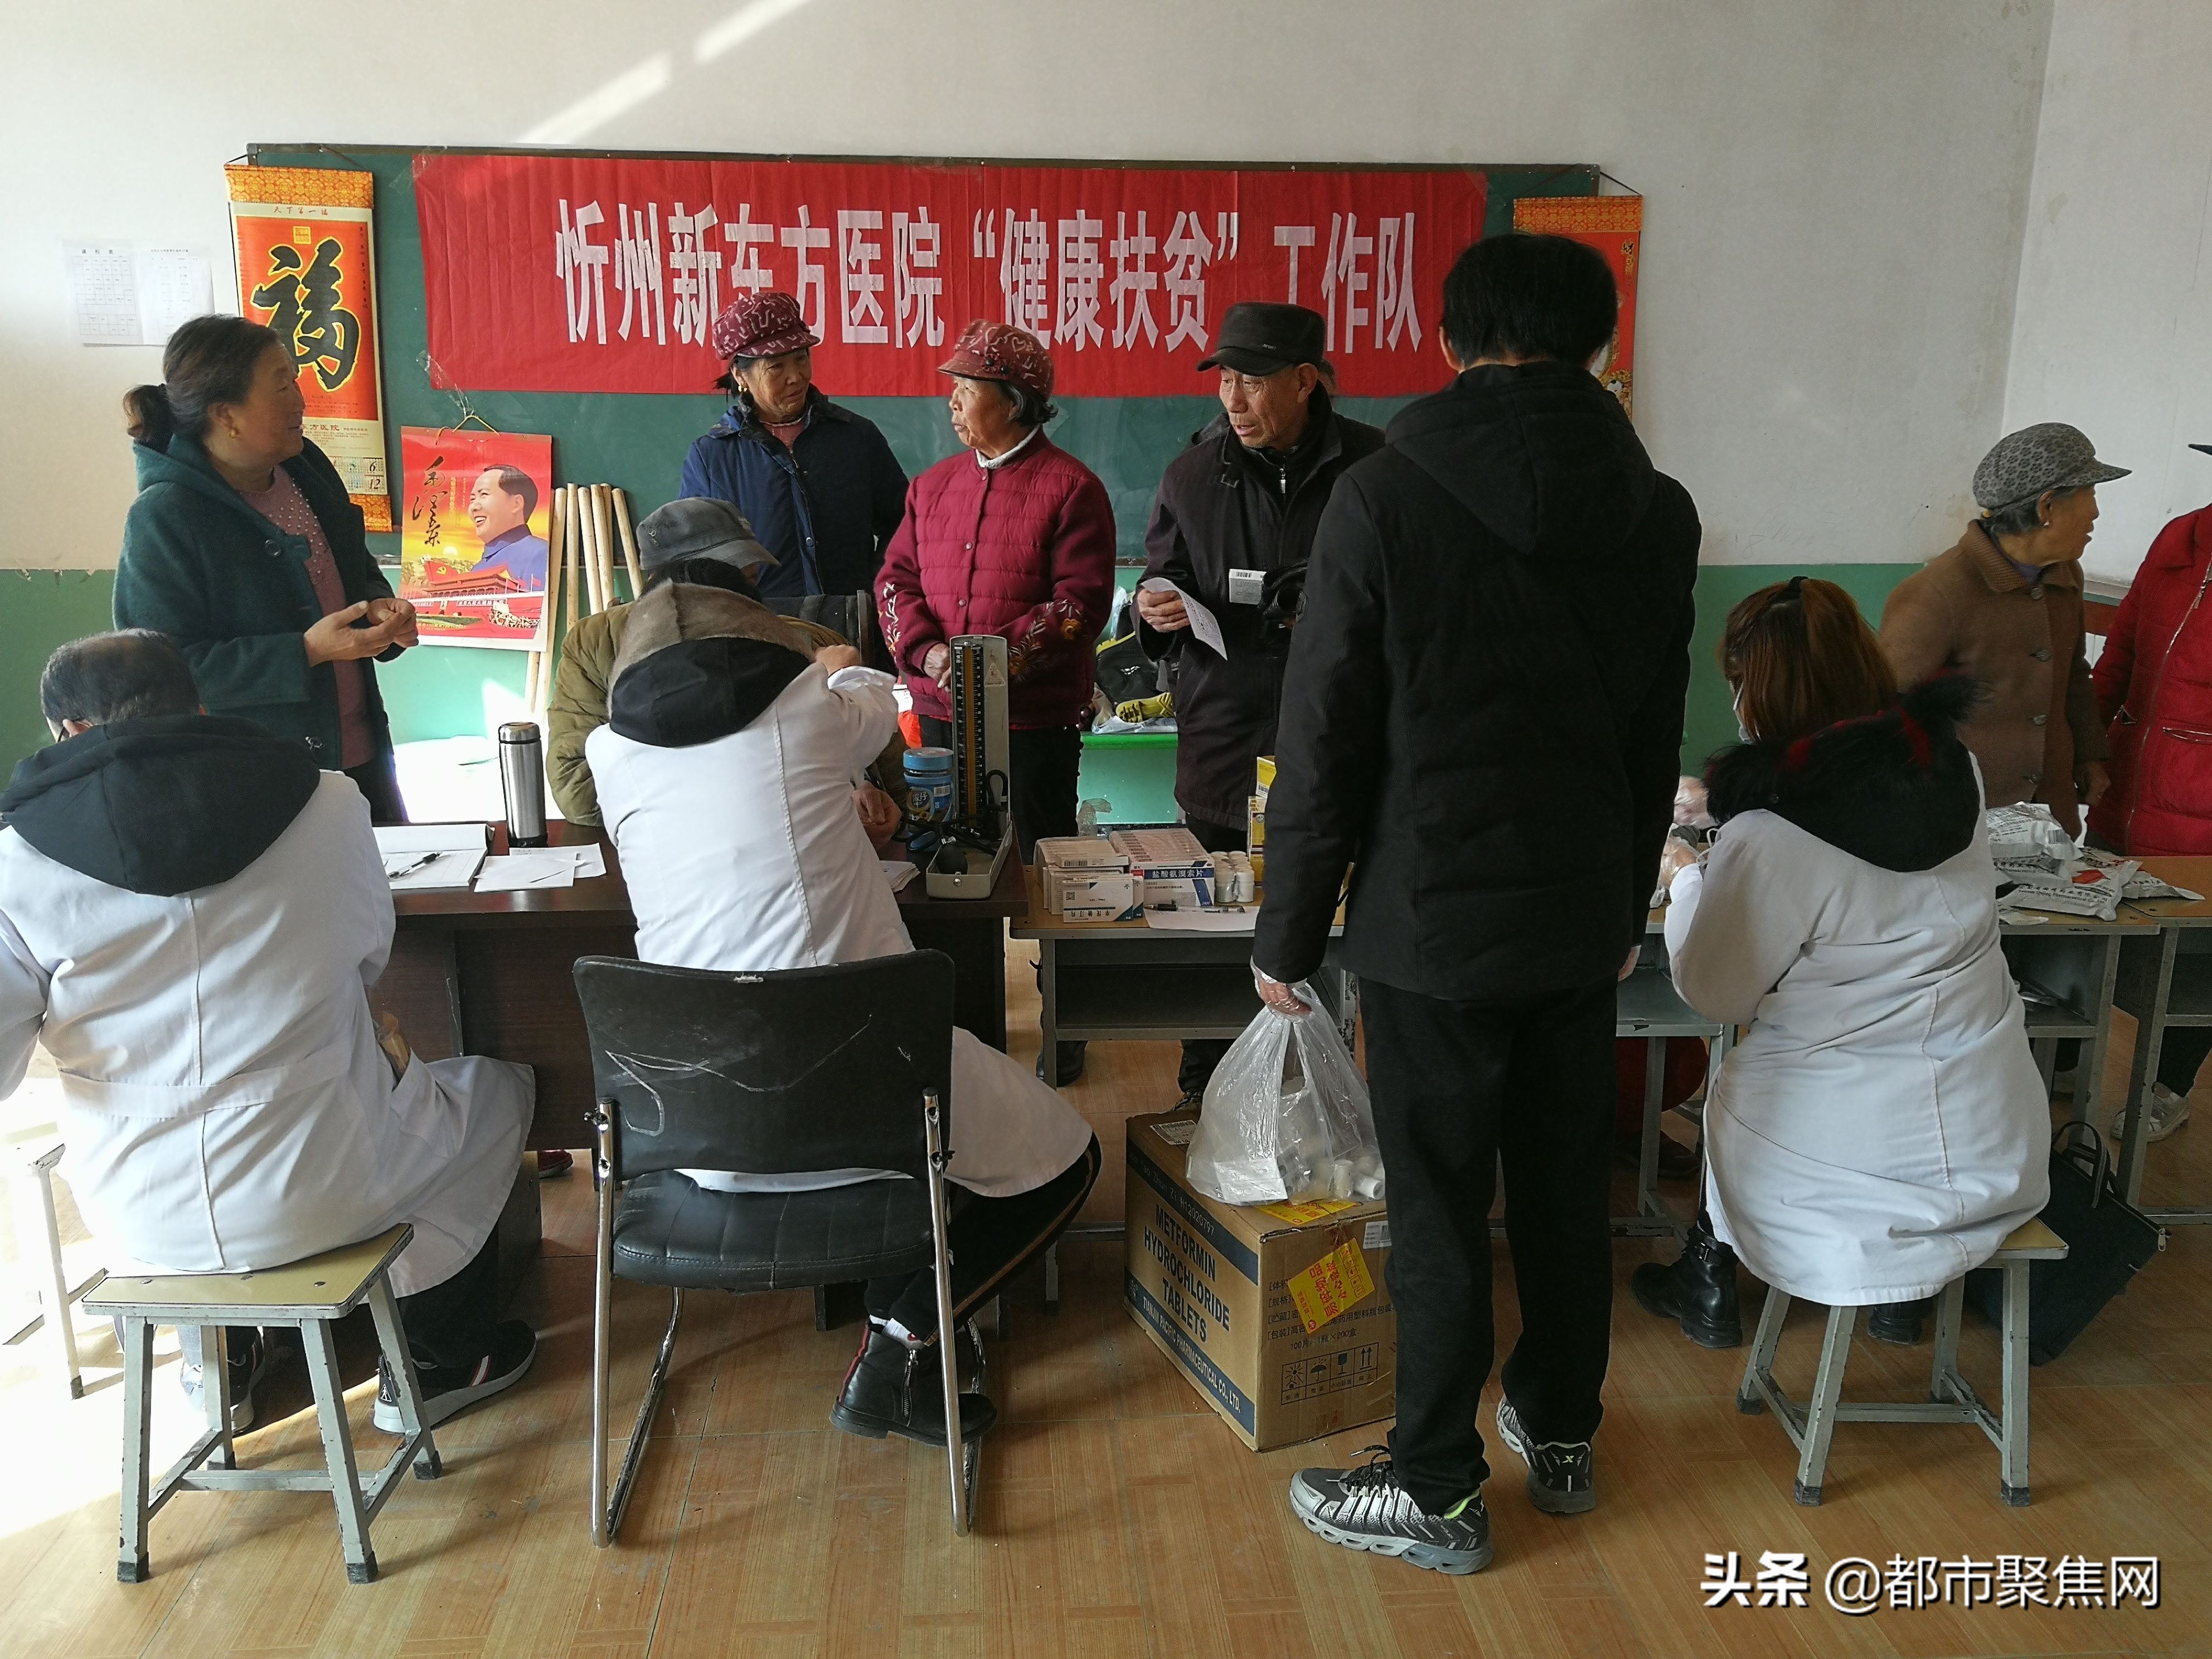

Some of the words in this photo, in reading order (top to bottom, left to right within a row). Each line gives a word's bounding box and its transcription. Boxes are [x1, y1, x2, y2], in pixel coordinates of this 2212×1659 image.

[370, 461, 377, 472] 6
[370, 479, 381, 489] 12
[1152, 870, 1204, 878] 盐酸氨溴索片
[1156, 1204, 1216, 1282] METFORMIN
[1180, 1197, 1214, 1236] H12020797
[1144, 1225, 1230, 1332] HYDROCHLORIDE
[1309, 1262, 1338, 1318] 易碎物品
[1163, 1277, 1206, 1342] TABLETS
[1160, 1312, 1176, 1345] PACIFIC
[1176, 1336, 1217, 1389] PHARMACEUTICAL
[1229, 1390, 1241, 1413] LTD.
